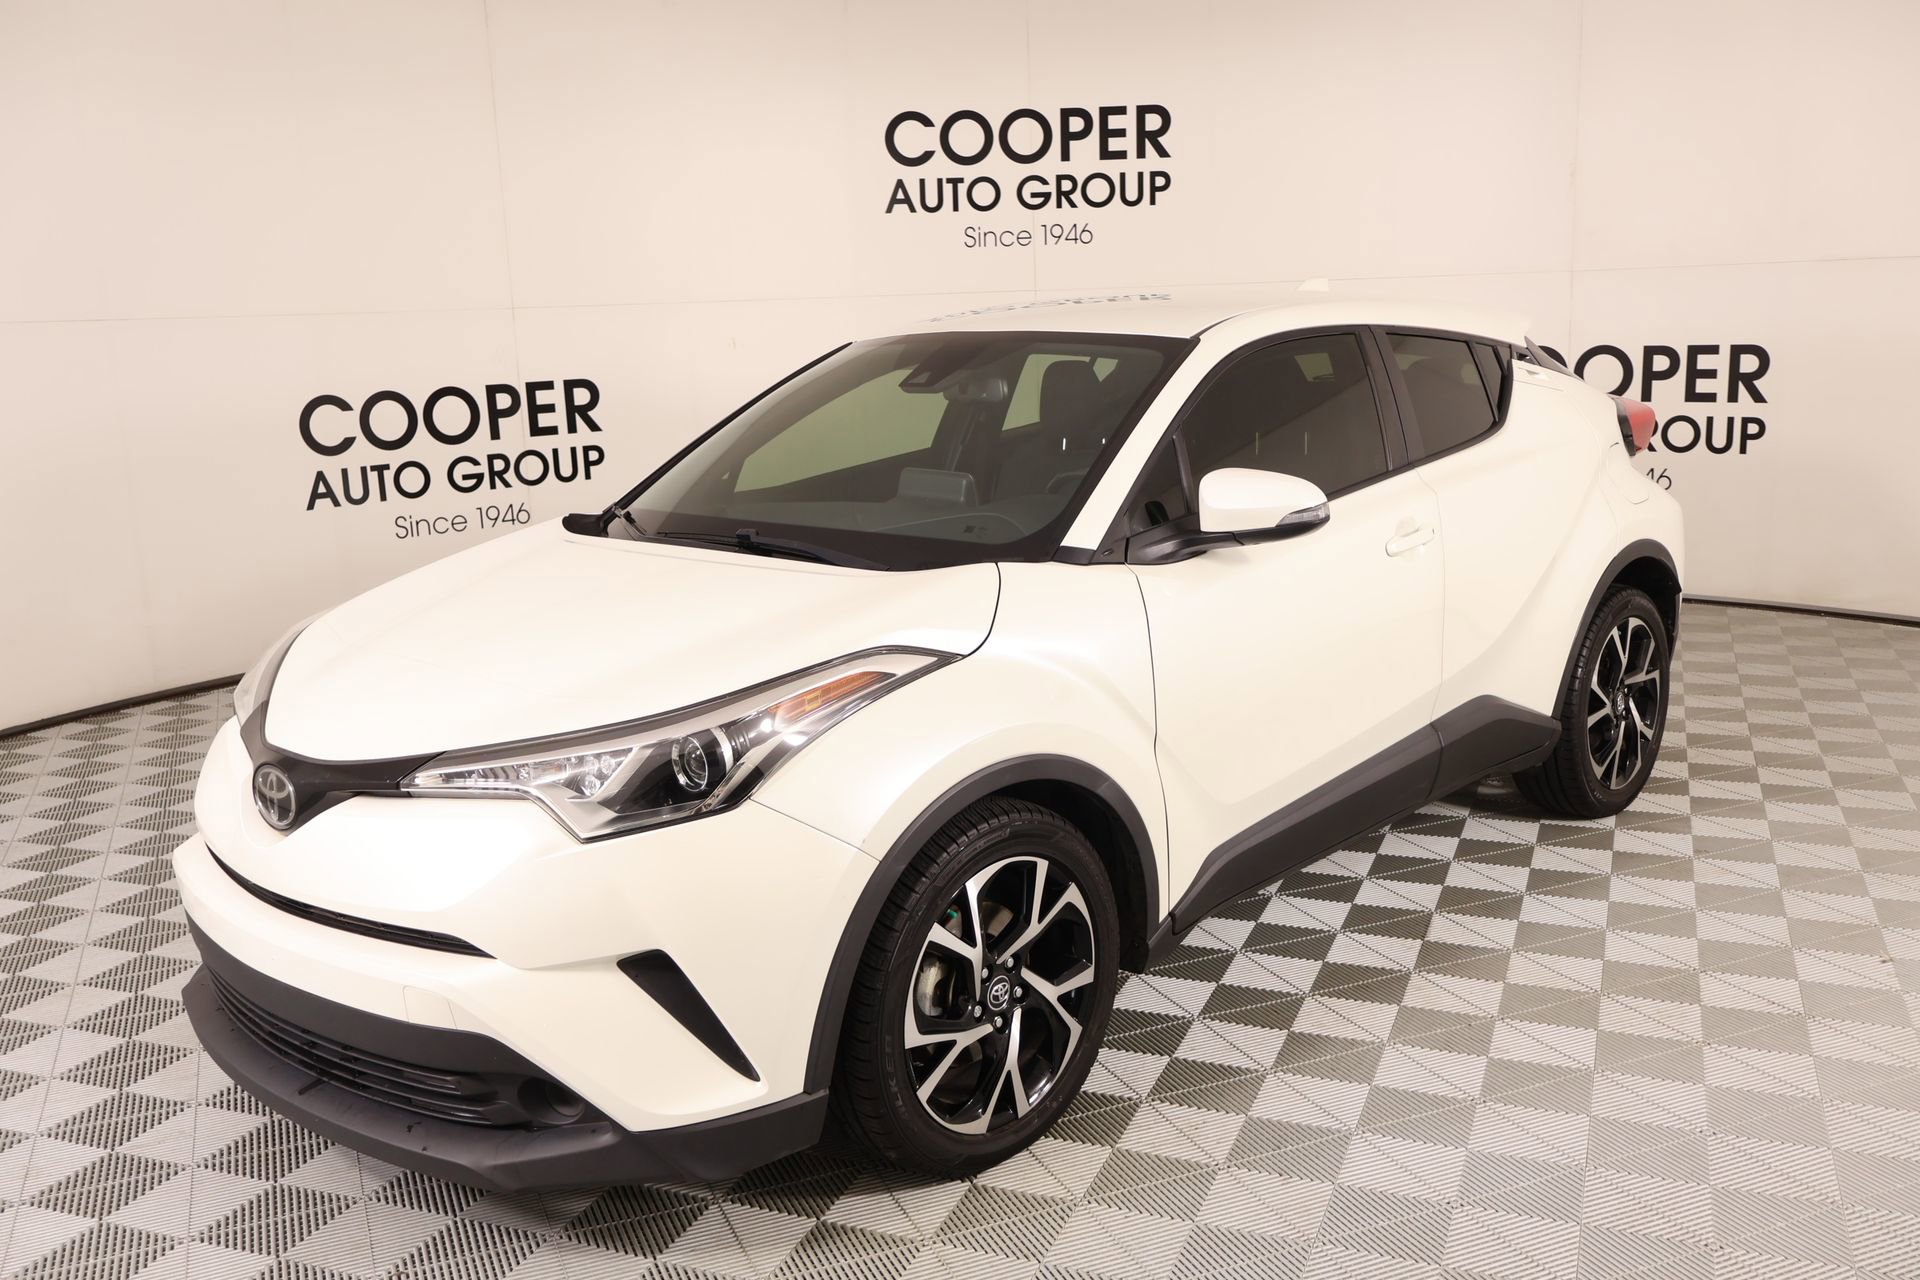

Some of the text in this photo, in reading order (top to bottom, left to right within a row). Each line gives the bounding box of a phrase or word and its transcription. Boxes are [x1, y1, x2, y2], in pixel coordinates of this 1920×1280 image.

[884, 104, 1172, 167] COOPER
[885, 170, 1172, 214] AUTO GROUP
[963, 222, 1094, 248] Since 1946
[298, 378, 603, 457] COOPER
[306, 444, 605, 511] AUTO GROUP
[394, 502, 531, 539] Since 1946
